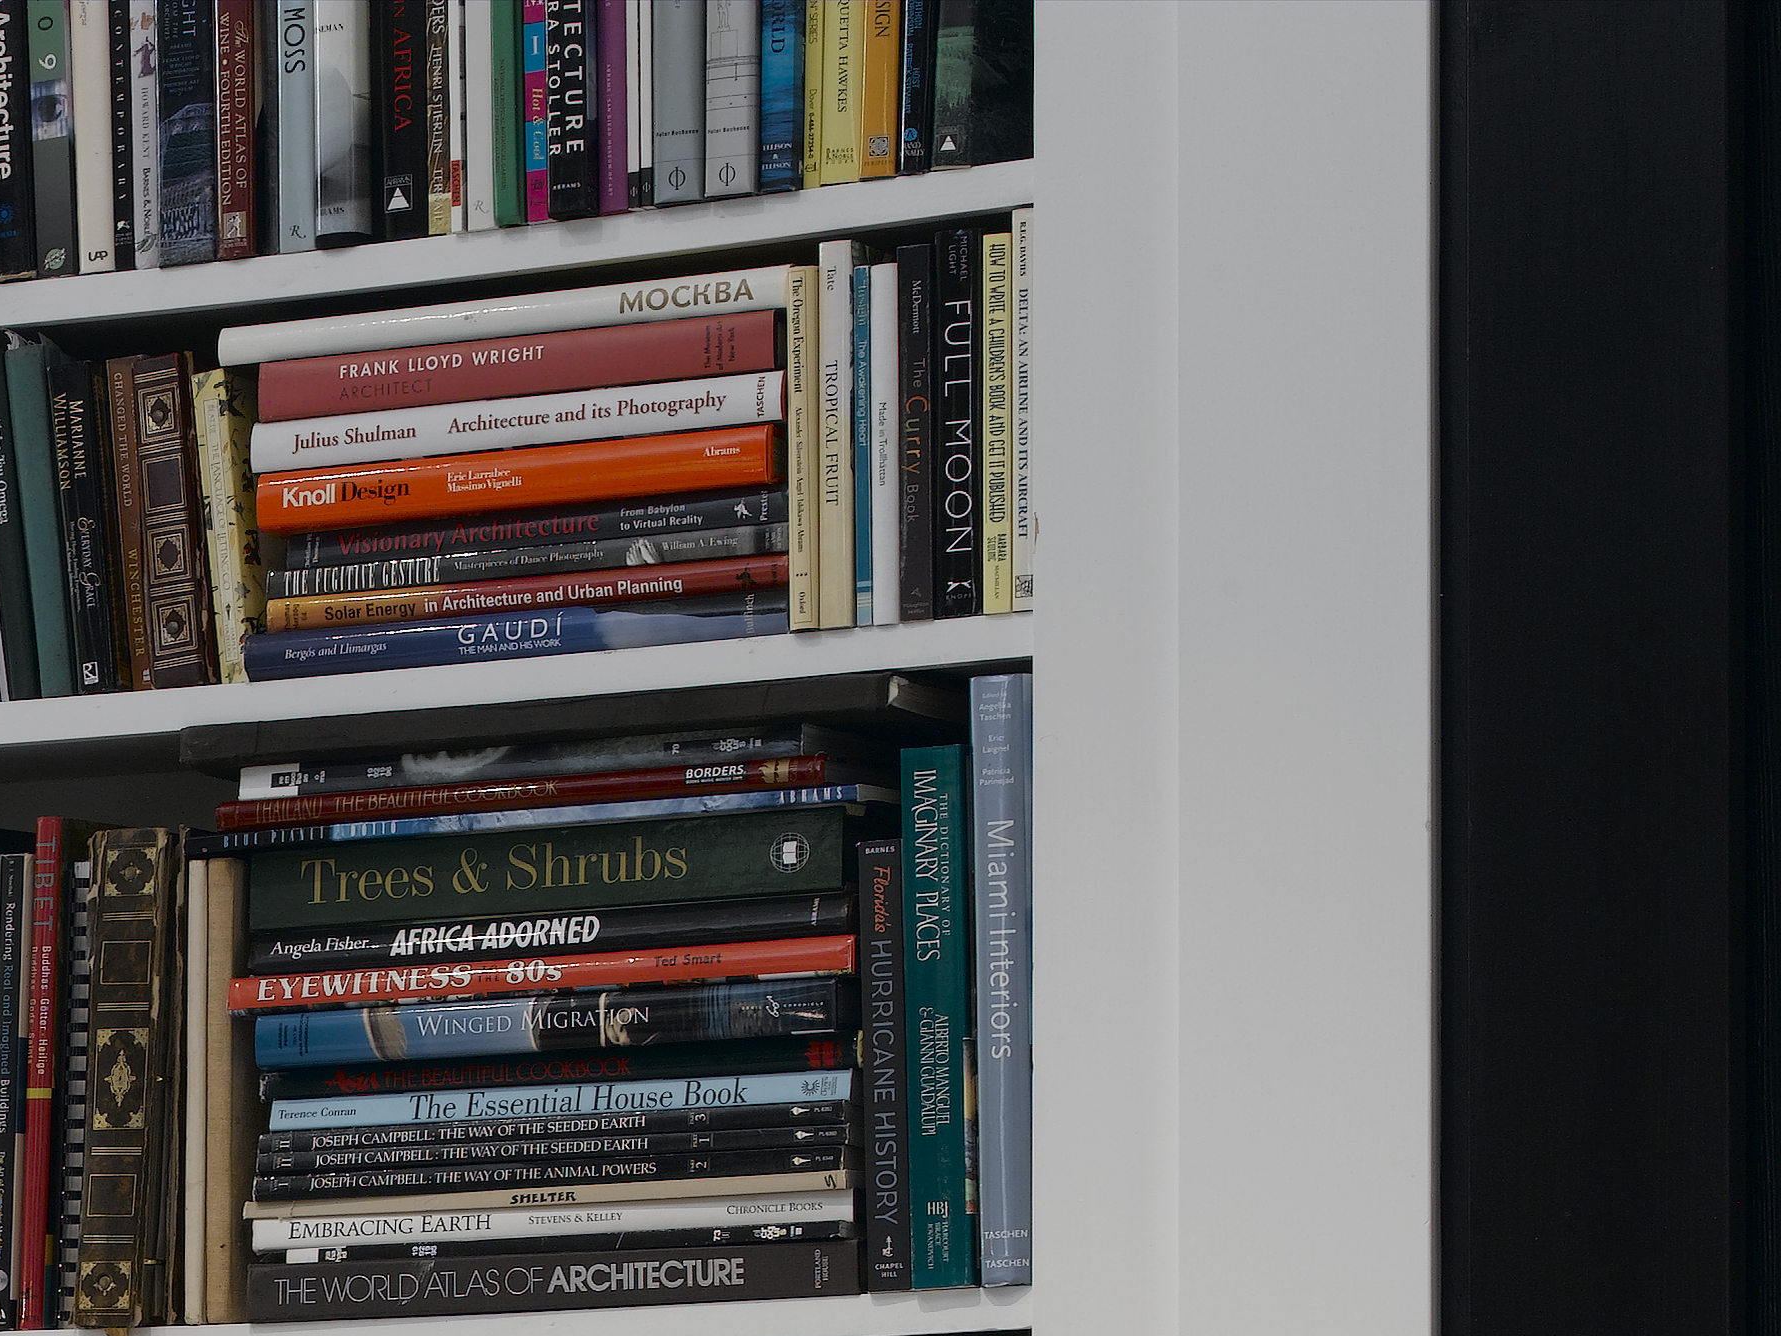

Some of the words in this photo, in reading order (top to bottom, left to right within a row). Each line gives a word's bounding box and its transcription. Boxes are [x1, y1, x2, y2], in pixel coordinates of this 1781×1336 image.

[338, 361, 400, 379] FRANK
[405, 354, 465, 374] LLOYD
[470, 344, 546, 366] WRIGHT
[944, 299, 972, 398] FULL
[291, 432, 338, 455] Julius
[344, 424, 417, 447] Shulman
[447, 408, 552, 434] Architecture
[555, 406, 588, 424] and
[591, 403, 614, 420] its
[619, 391, 727, 423] Photography
[281, 485, 337, 509] Knoll
[340, 479, 411, 504] Design
[944, 418, 973, 554] MOON
[299, 854, 435, 907] Trees
[451, 846, 491, 896] &
[504, 838, 689, 893] Shrubs
[985, 820, 1014, 921] Miami
[390, 922, 476, 959] AFRICA
[480, 916, 601, 950] ADORNED
[257, 963, 472, 1001] EYEWITNESS
[988, 928, 1014, 1060] Interiors
[409, 1093, 459, 1123] The
[465, 1086, 587, 1118] Essential
[592, 1082, 676, 1114] House
[681, 1078, 749, 1107] Book
[274, 1276, 317, 1305] THE
[321, 1272, 420, 1306] WORLD
[423, 1271, 500, 1301] ATLAS
[503, 1267, 544, 1296] OF
[547, 1259, 745, 1293] ARCHITECTURE
